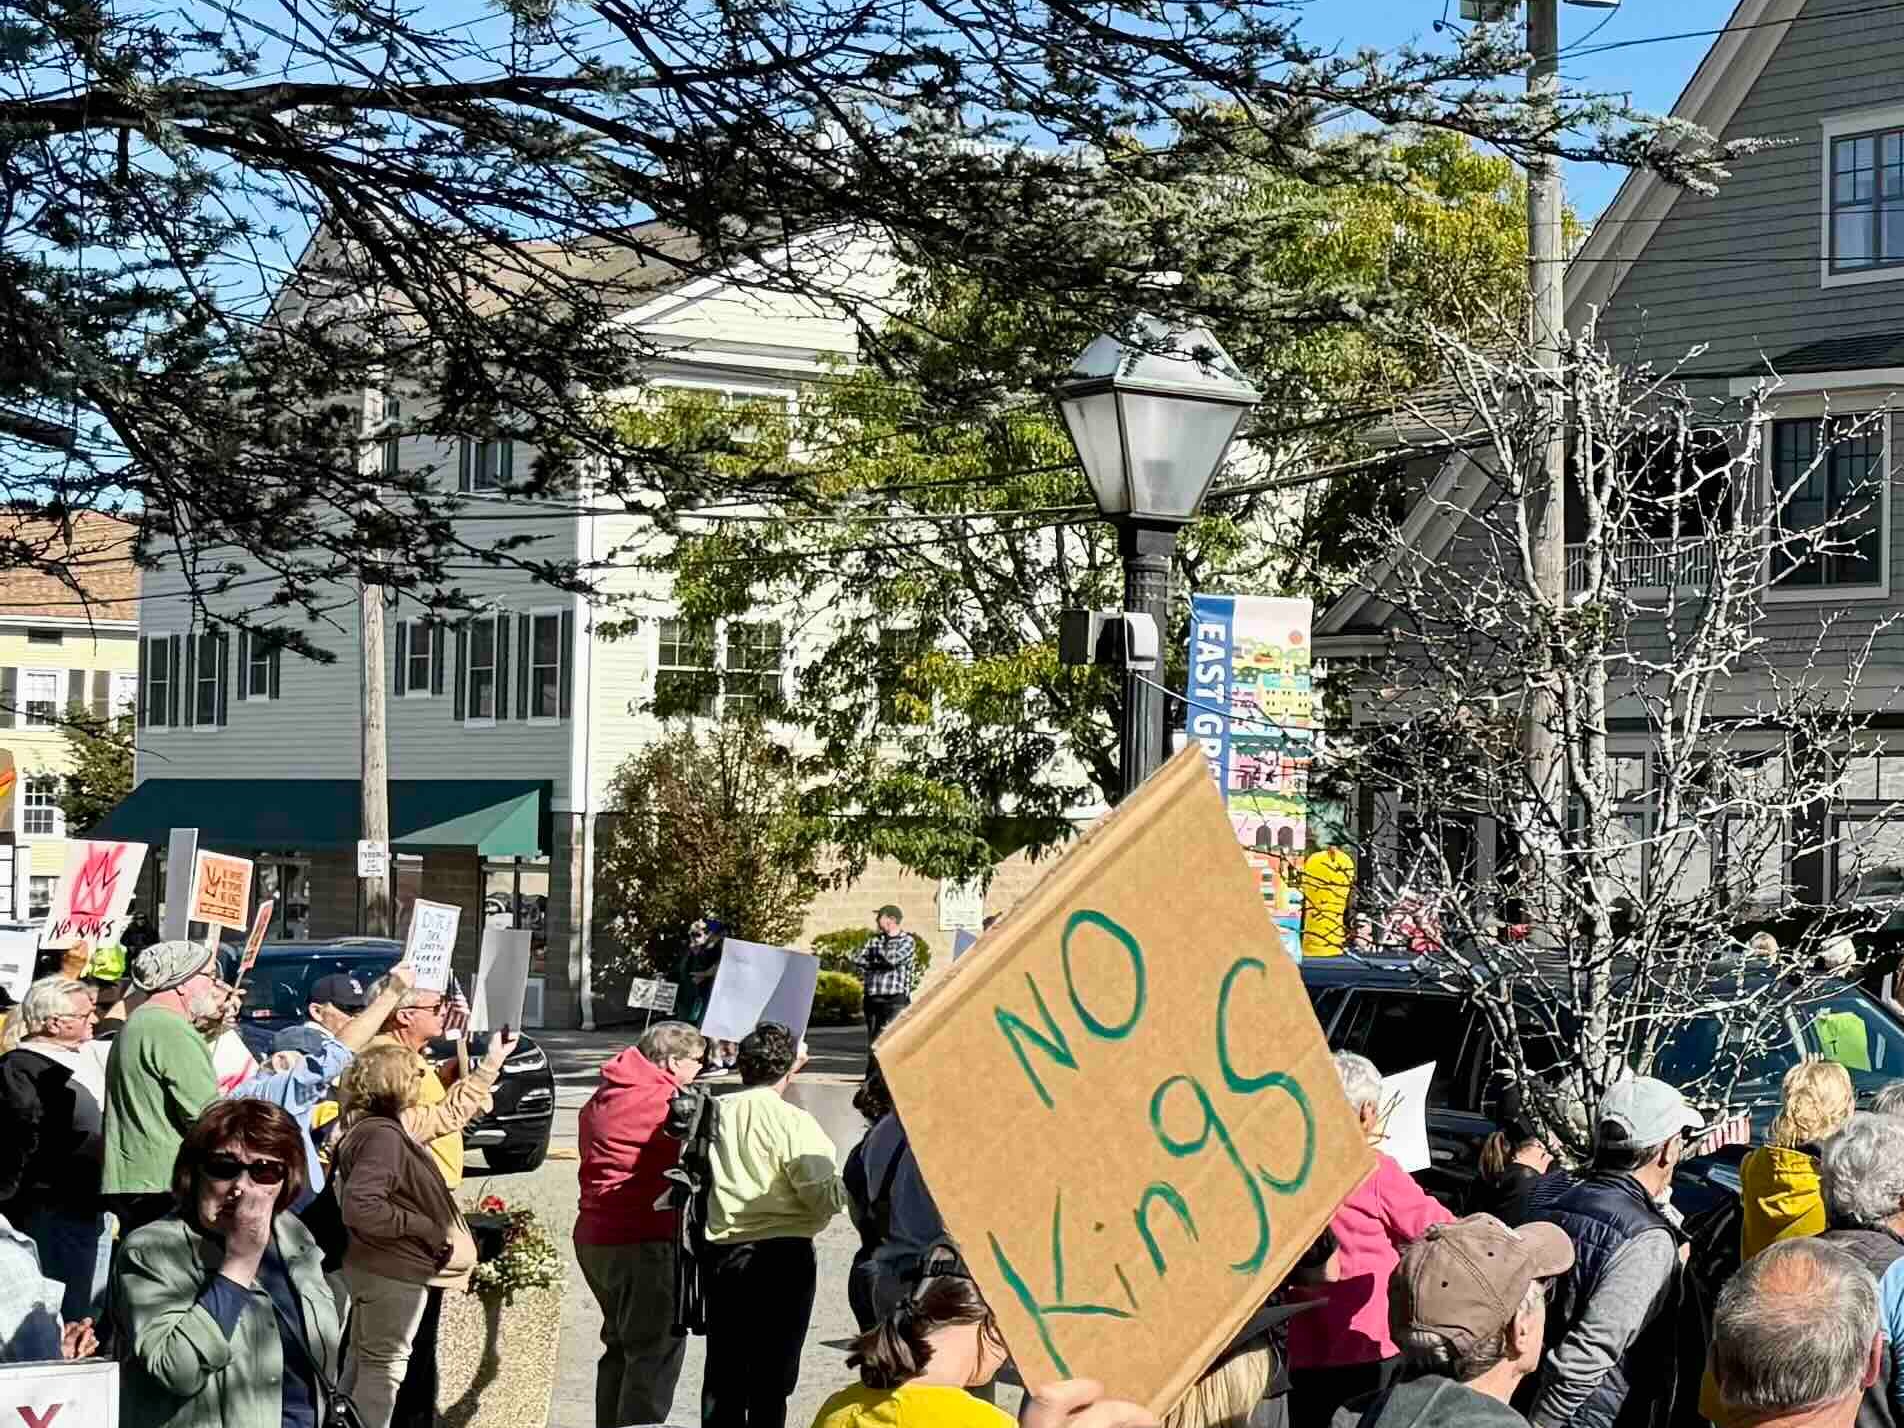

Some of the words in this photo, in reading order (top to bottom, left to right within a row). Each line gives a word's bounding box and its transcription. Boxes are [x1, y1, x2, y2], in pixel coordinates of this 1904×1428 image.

[1195, 622, 1226, 704] EAST
[48, 919, 71, 940] NO
[994, 909, 1147, 1111] NO
